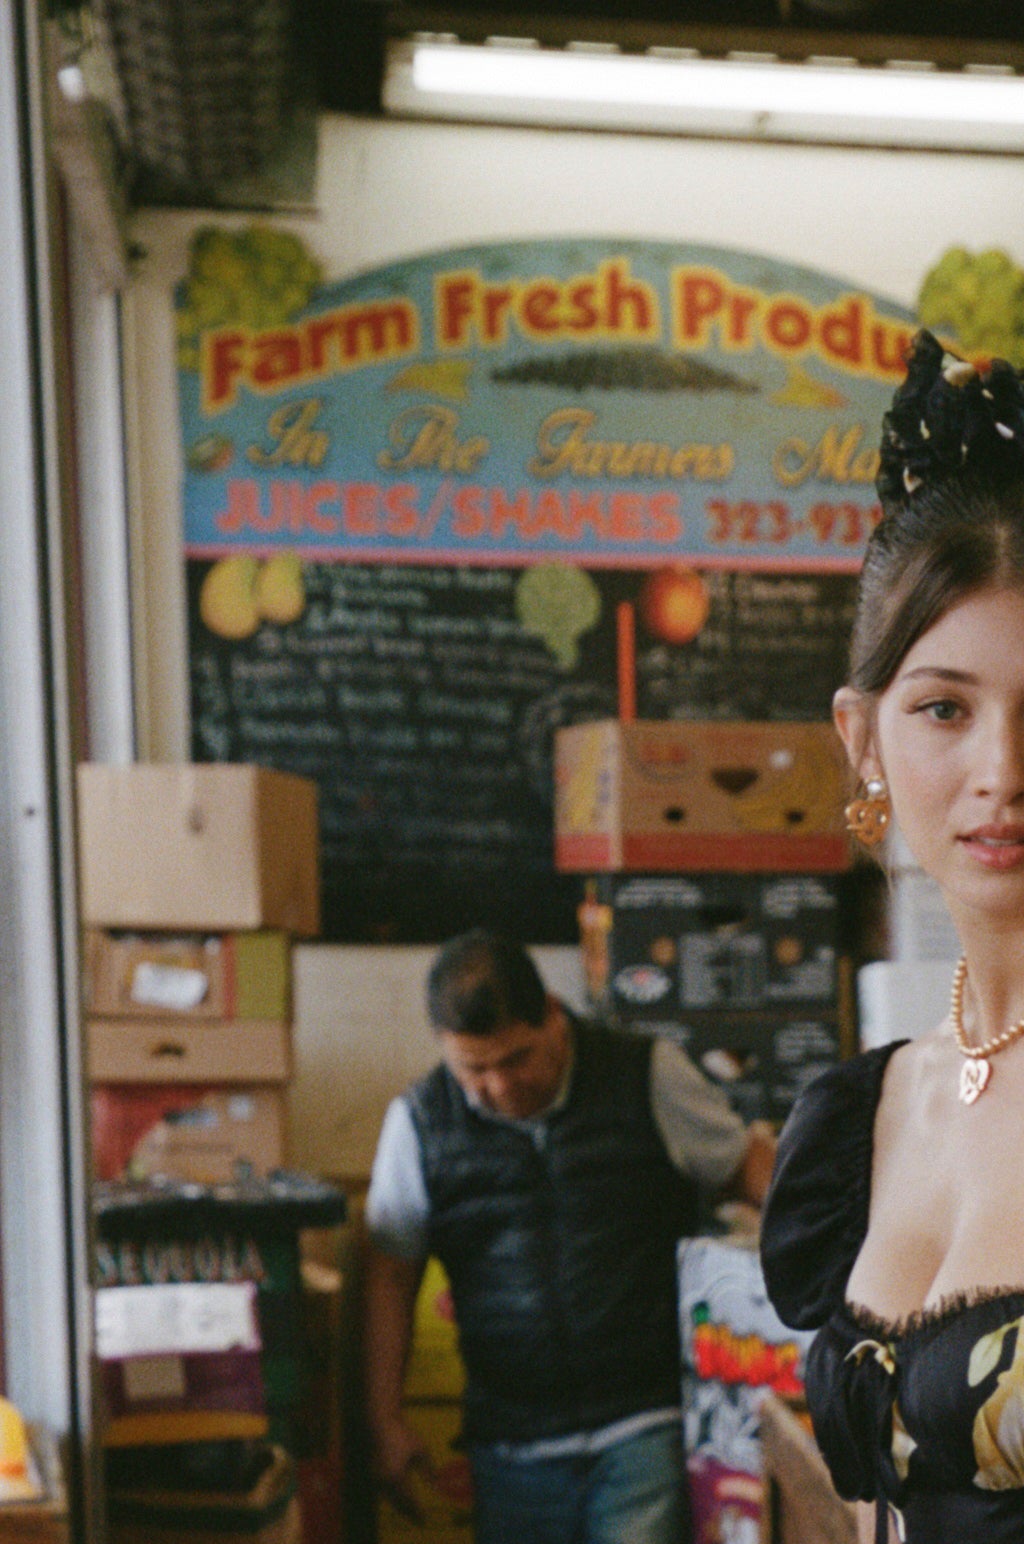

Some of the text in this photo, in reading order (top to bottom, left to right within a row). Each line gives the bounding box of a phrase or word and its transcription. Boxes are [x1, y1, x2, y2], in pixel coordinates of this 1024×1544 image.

[204, 258, 911, 408] Farm Fresh Produ
[248, 401, 331, 469] In
[377, 405, 489, 475] The
[527, 406, 736, 480] Farmers
[213, 479, 683, 544] JUICES/SHAKES
